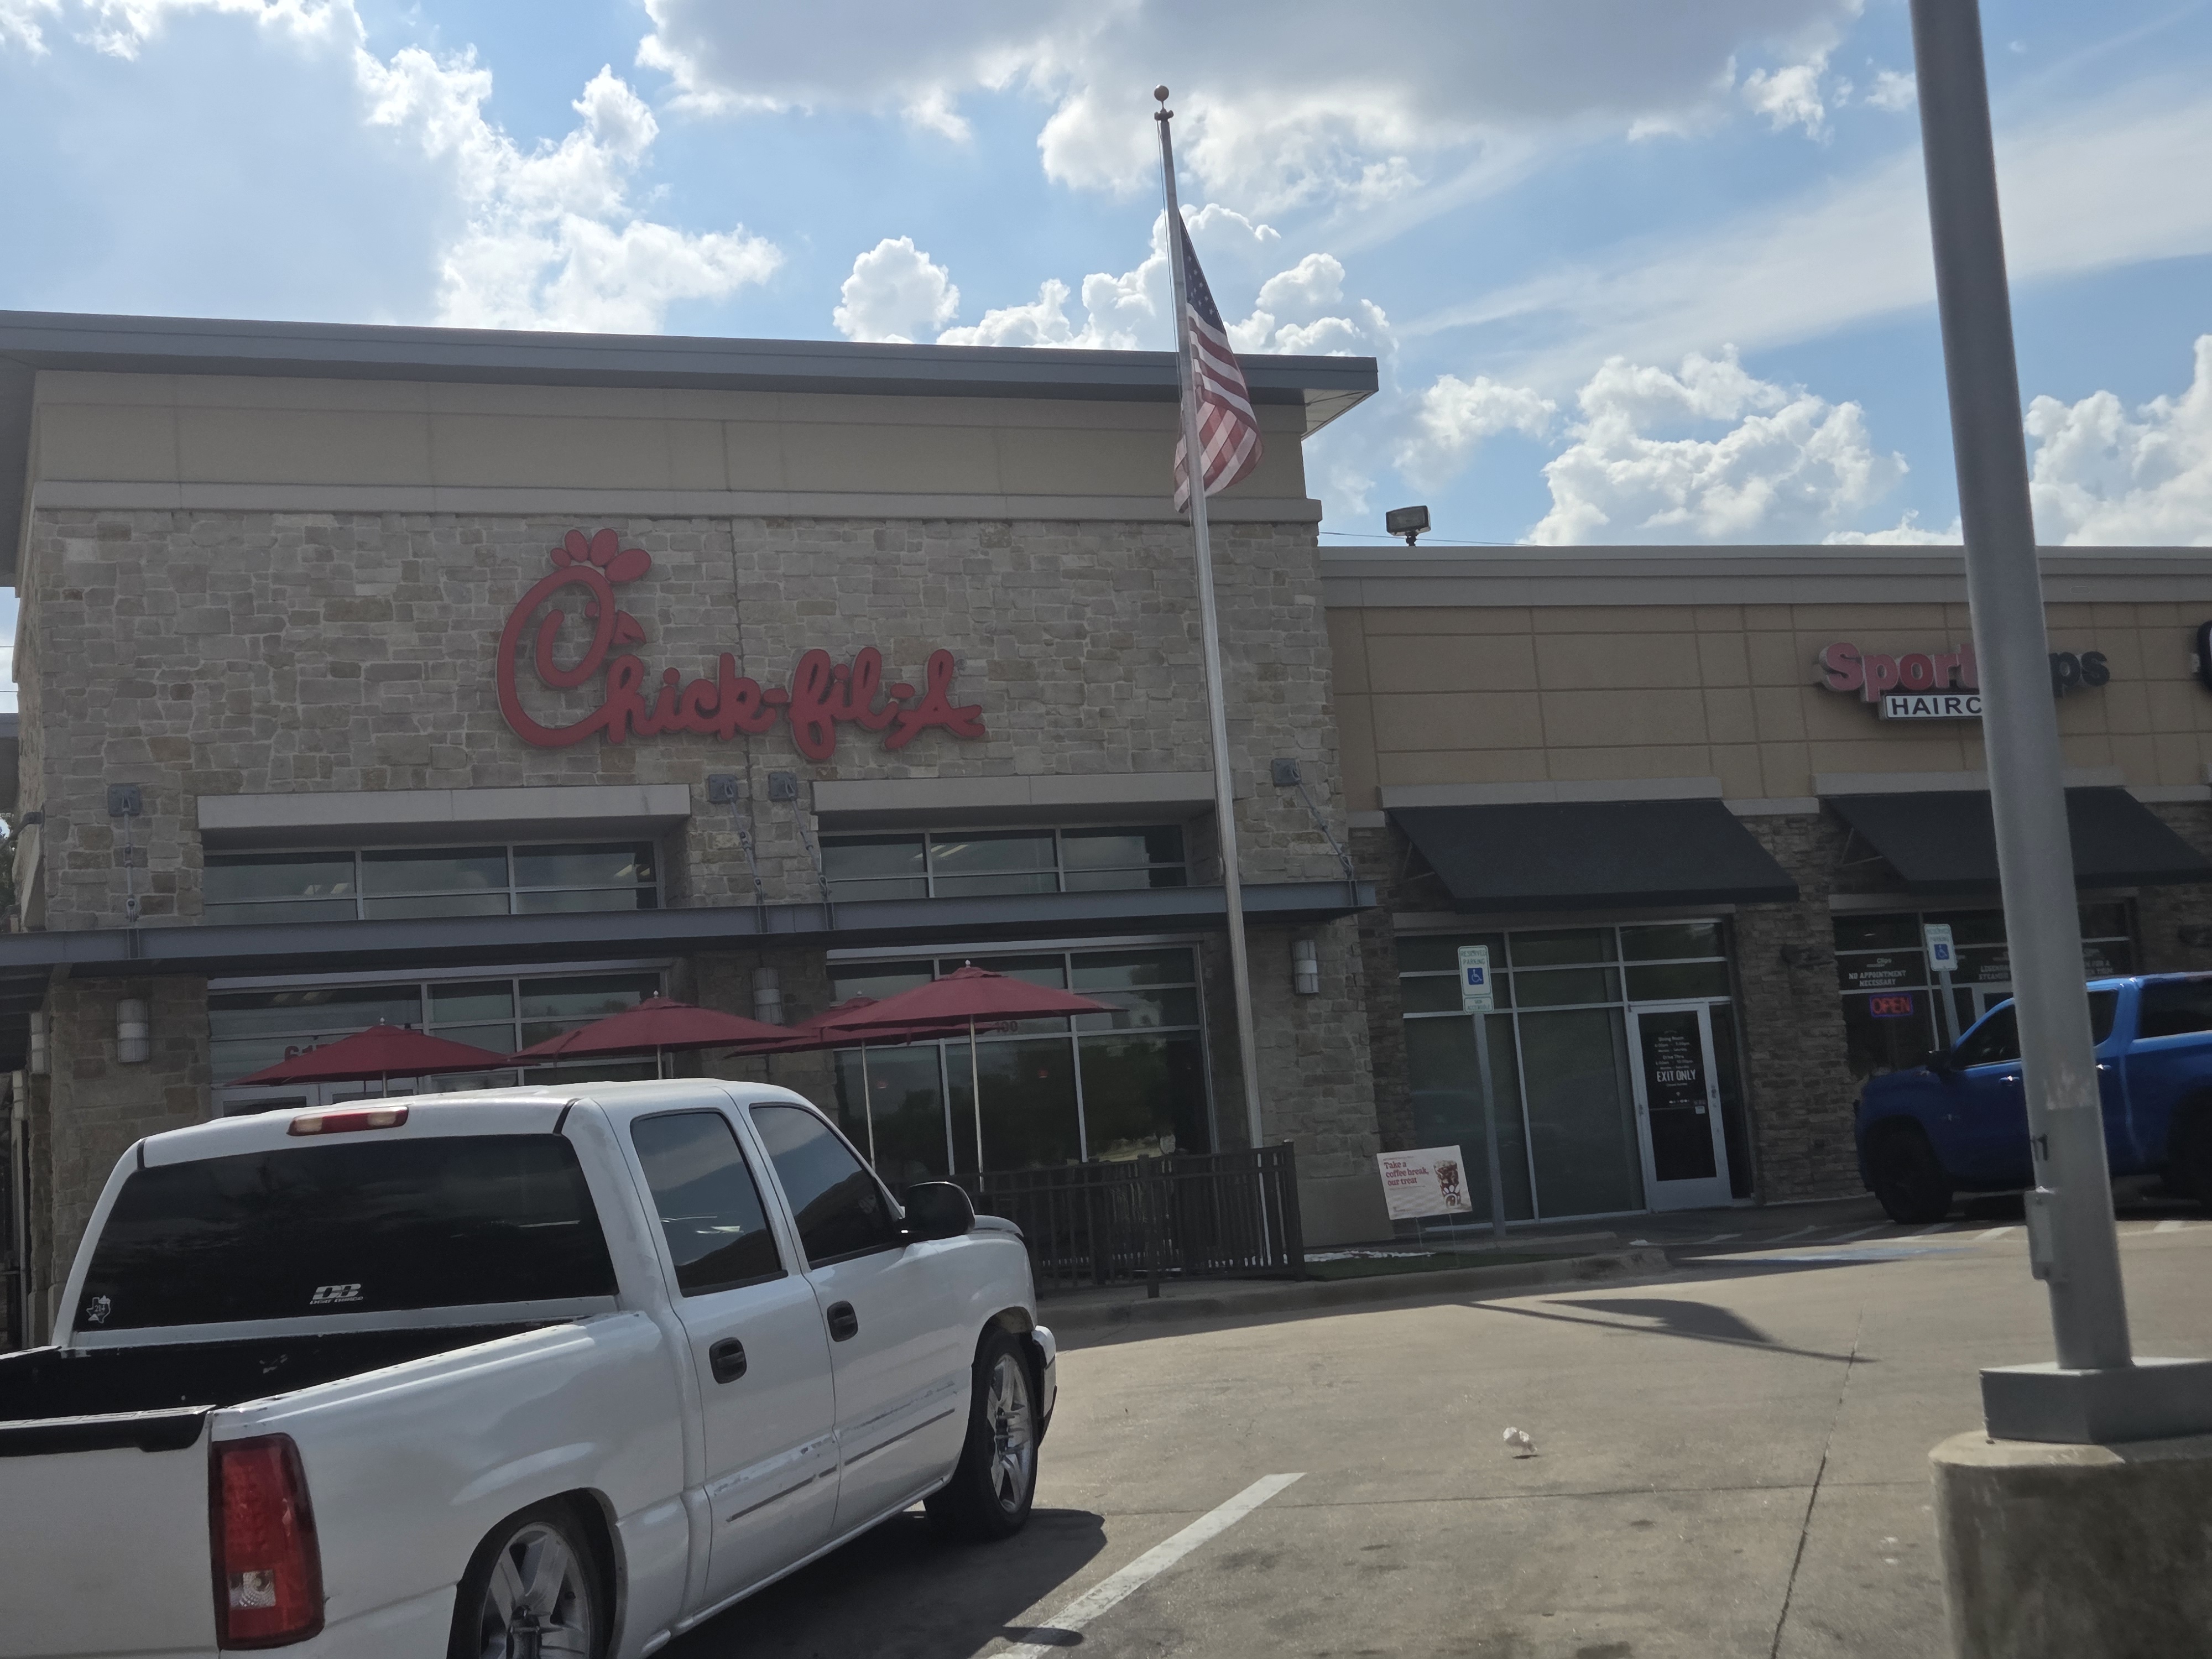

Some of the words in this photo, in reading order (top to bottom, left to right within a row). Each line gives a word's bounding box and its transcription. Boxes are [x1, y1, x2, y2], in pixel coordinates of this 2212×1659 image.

[497, 563, 985, 760] Chick-fil-A
[1891, 696, 1982, 716] HAIRC
[1859, 969, 1907, 979] APPOINTMENT
[1859, 978, 1896, 987] NECESSARY
[1872, 996, 1911, 1015] OPEN
[1656, 1071, 1674, 1082] EXIT
[1676, 1068, 1696, 1081] ONLY
[1384, 1161, 1401, 1169] Take
[1385, 1169, 1407, 1178] coffee
[1407, 1167, 1429, 1176] break,
[94, 1304, 106, 1312] 214
